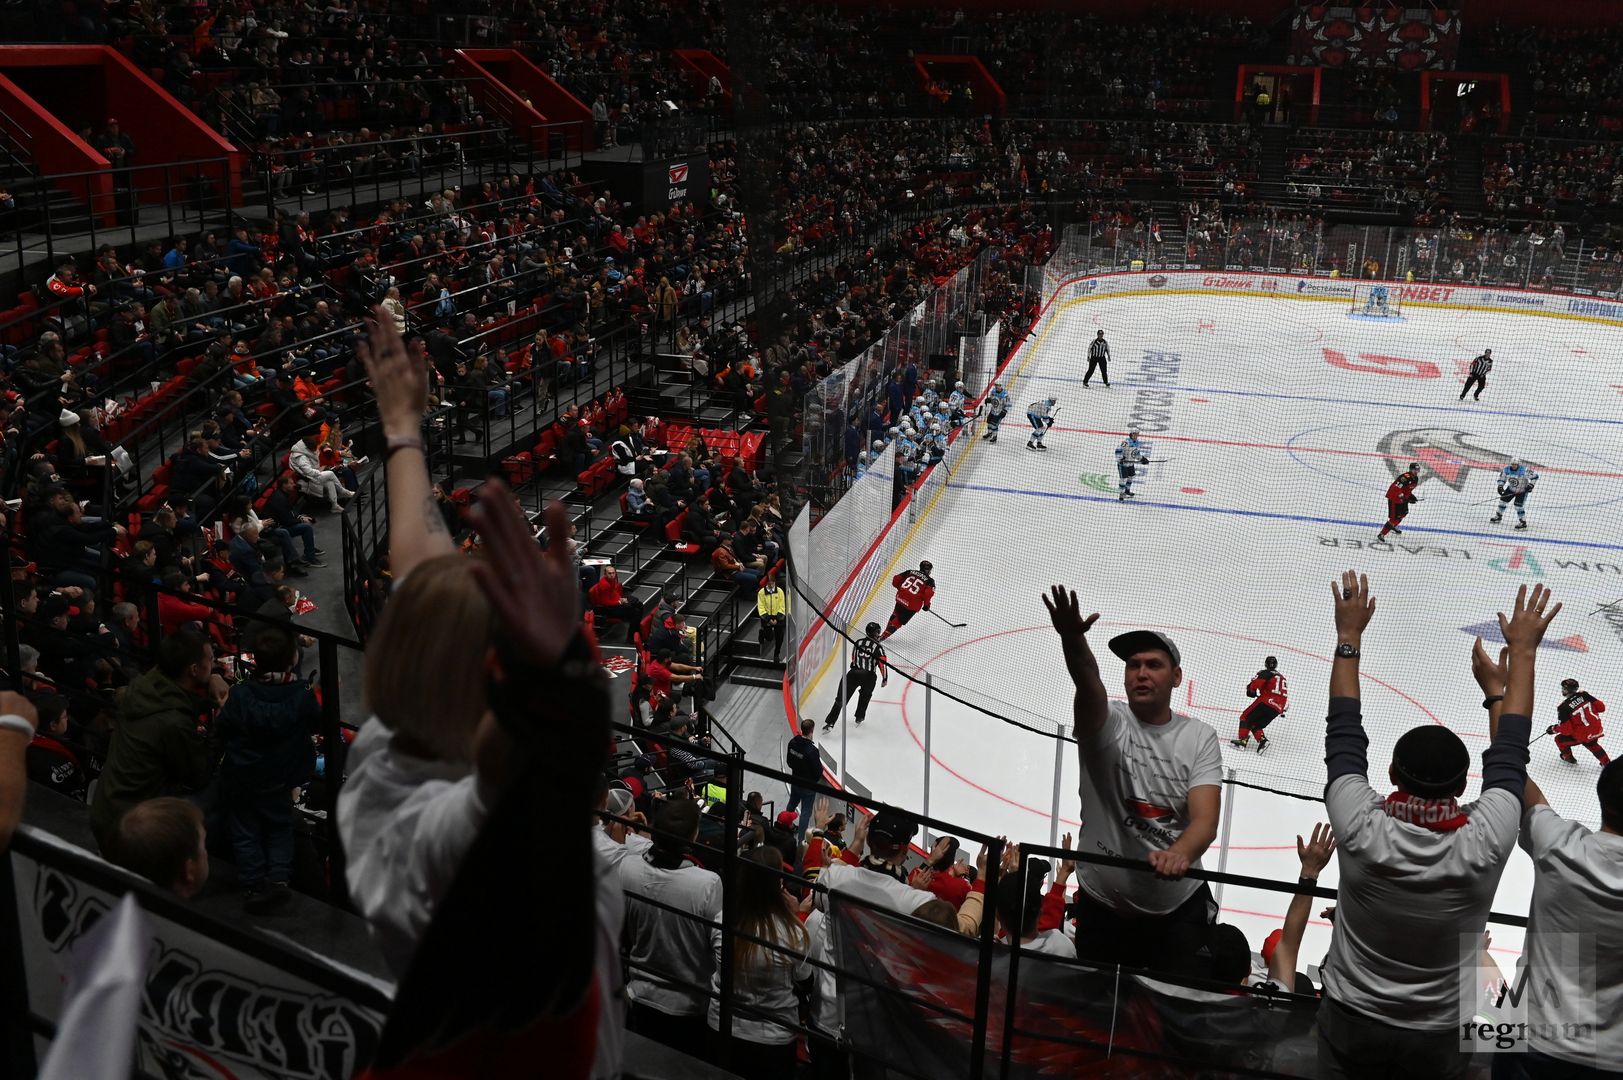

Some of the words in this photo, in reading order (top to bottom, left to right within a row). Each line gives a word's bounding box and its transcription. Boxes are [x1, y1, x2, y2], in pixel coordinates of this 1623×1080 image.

[1319, 535, 1472, 560] LEADER
[901, 576, 924, 595] 65
[1572, 701, 1599, 727] 77
